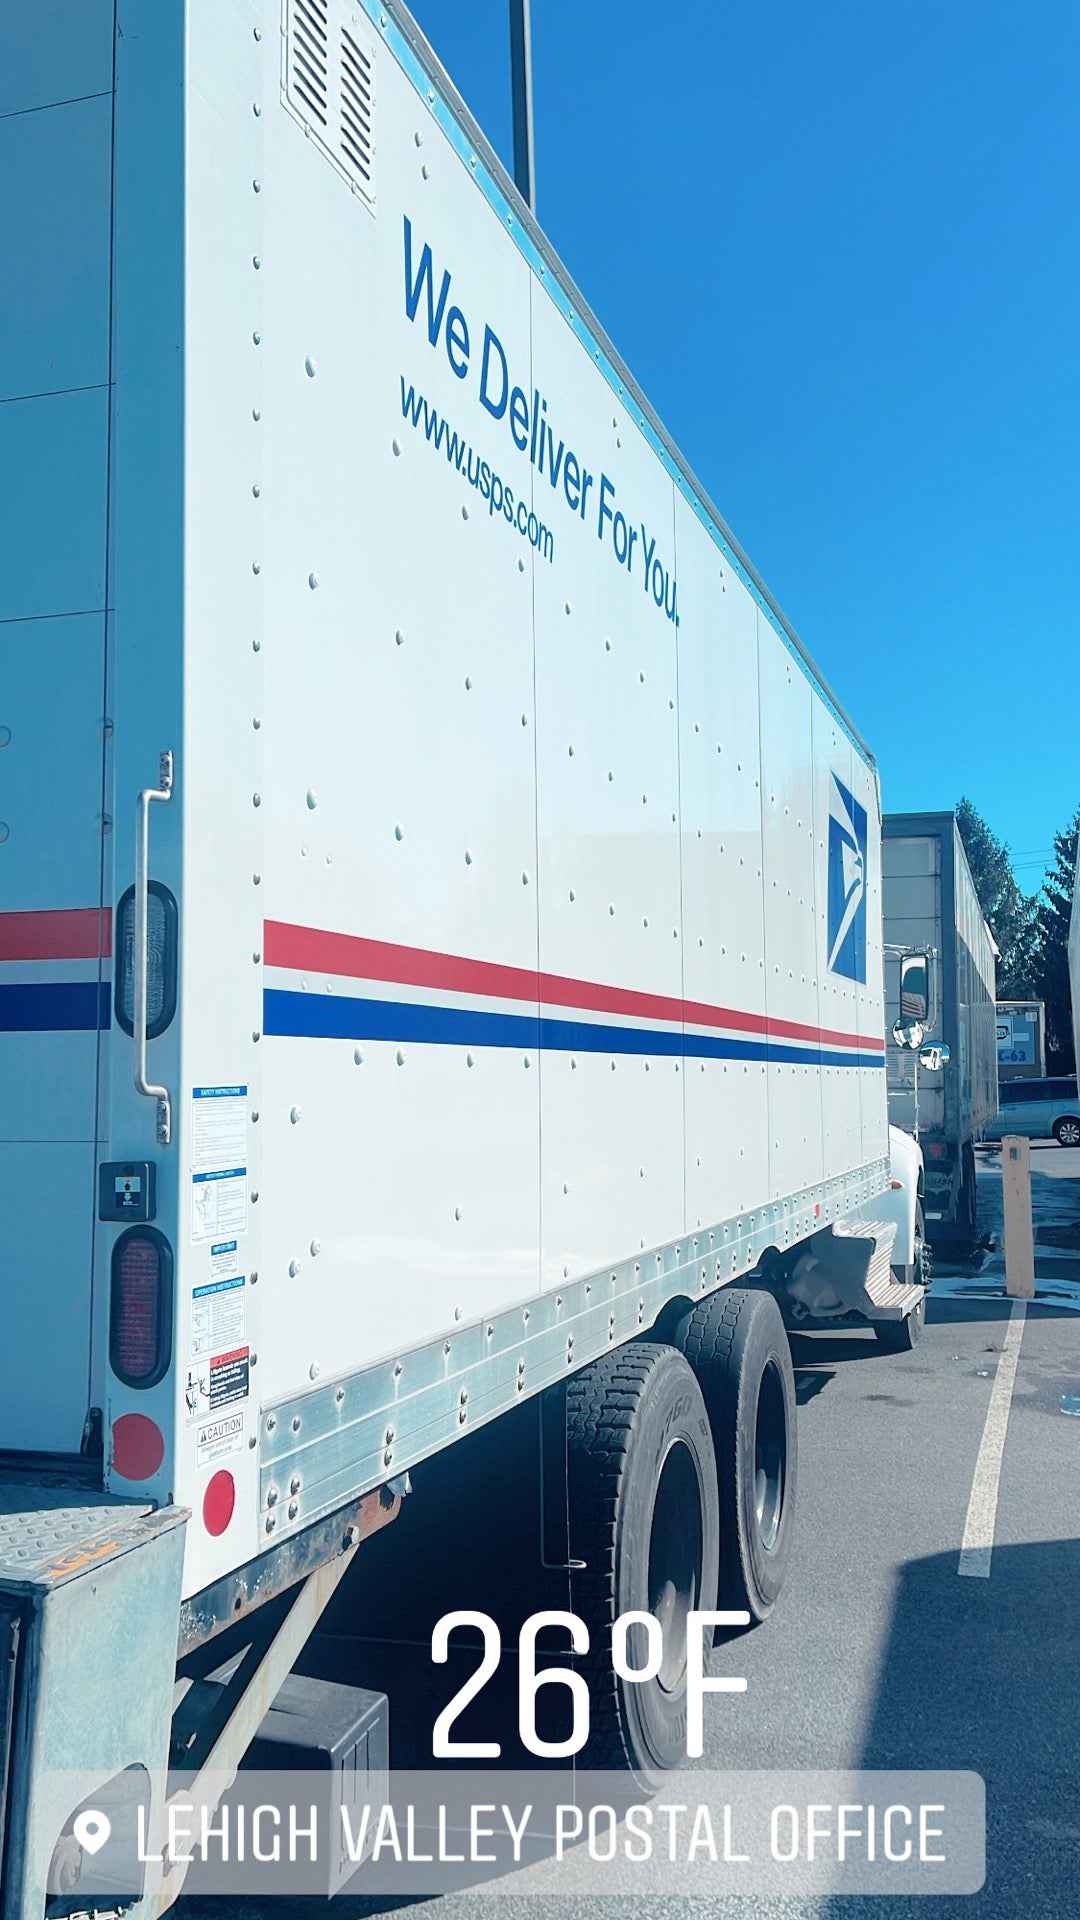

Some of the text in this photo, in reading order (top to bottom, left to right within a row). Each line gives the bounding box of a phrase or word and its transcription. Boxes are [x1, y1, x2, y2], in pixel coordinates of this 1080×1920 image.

[400, 374, 556, 564] www.usps.com
[403, 213, 682, 629] We Deliver For You.
[207, 1416, 242, 1440] CAUTION
